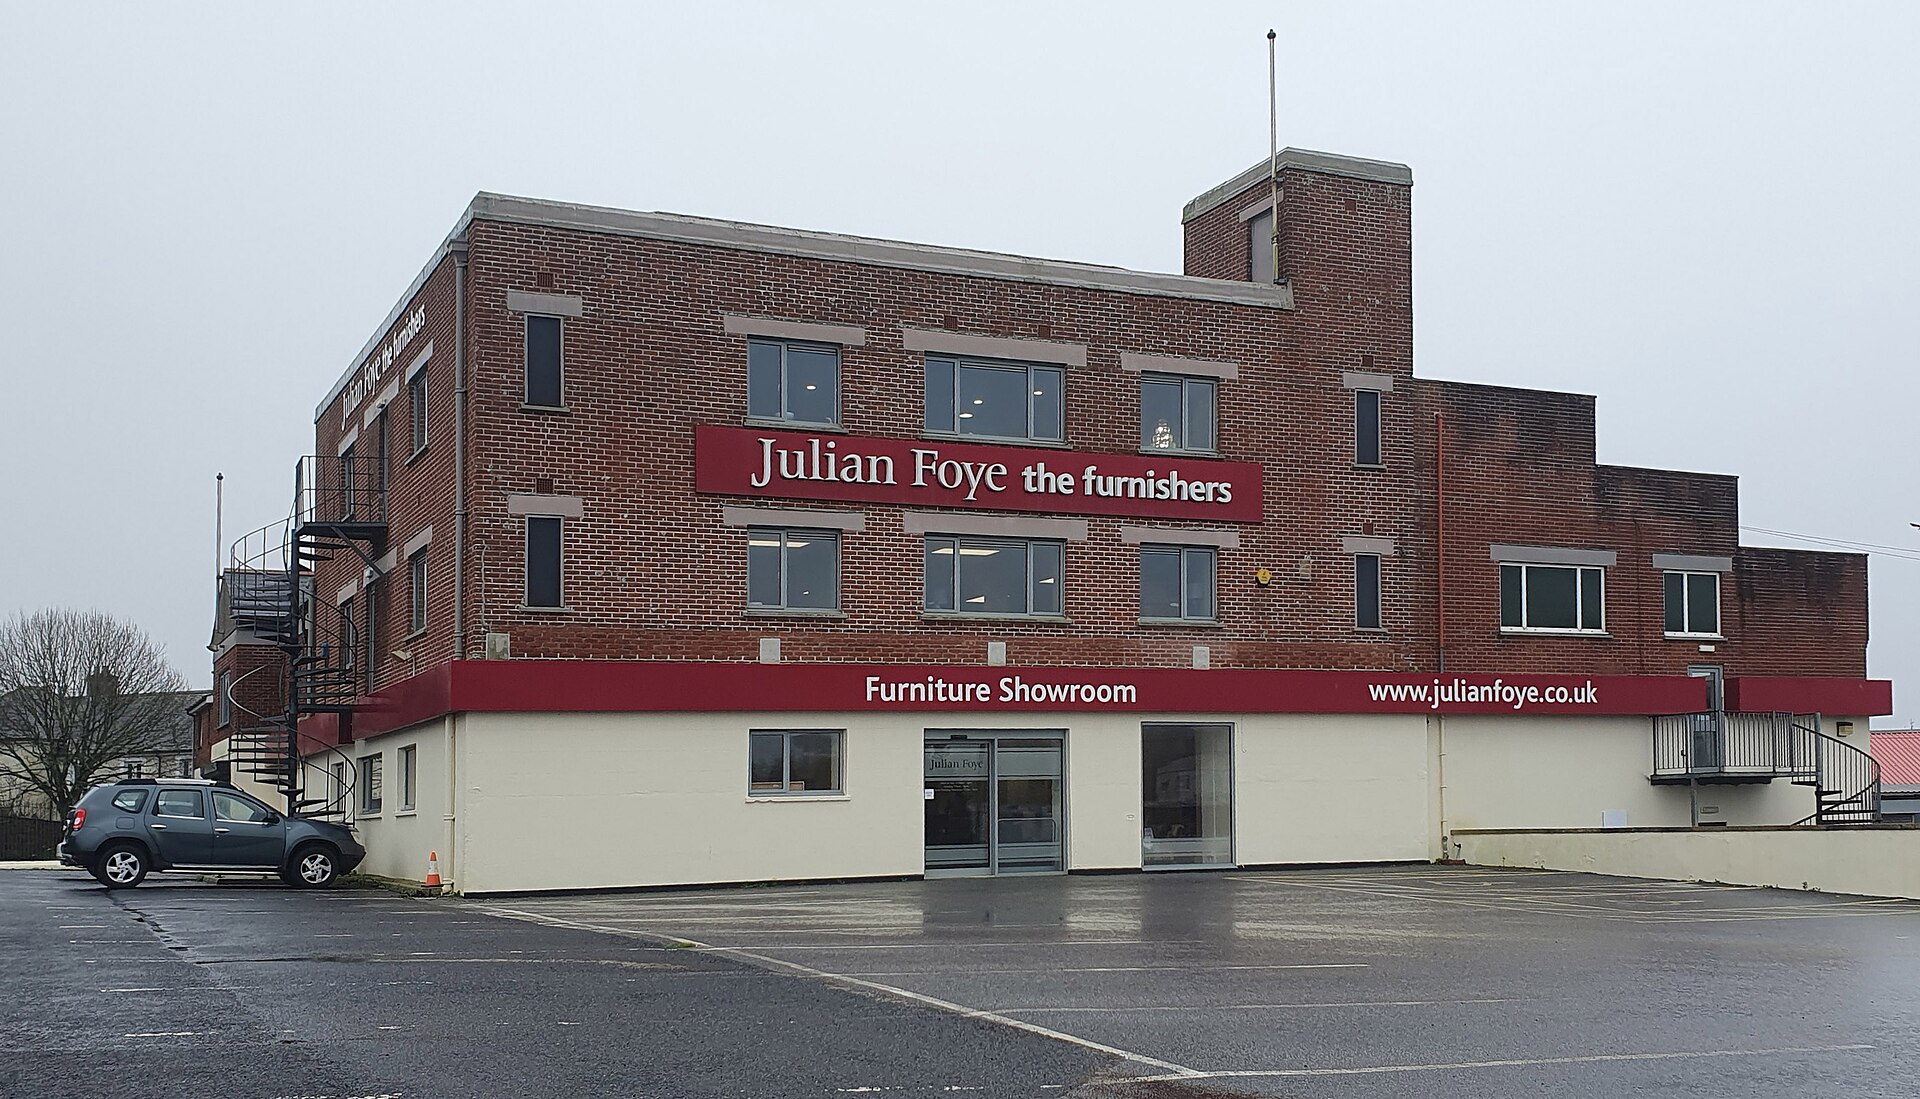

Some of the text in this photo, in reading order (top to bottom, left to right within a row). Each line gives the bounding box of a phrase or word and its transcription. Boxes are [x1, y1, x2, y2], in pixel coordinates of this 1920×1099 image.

[341, 303, 426, 431] Julian Foye the furnishers
[750, 437, 1233, 503] Julian Foye the furnishers
[865, 675, 1137, 703] Furniture Showroom
[1367, 678, 1599, 710] www.julianfoye.co.uk
[929, 758, 984, 771] Julian Foye
